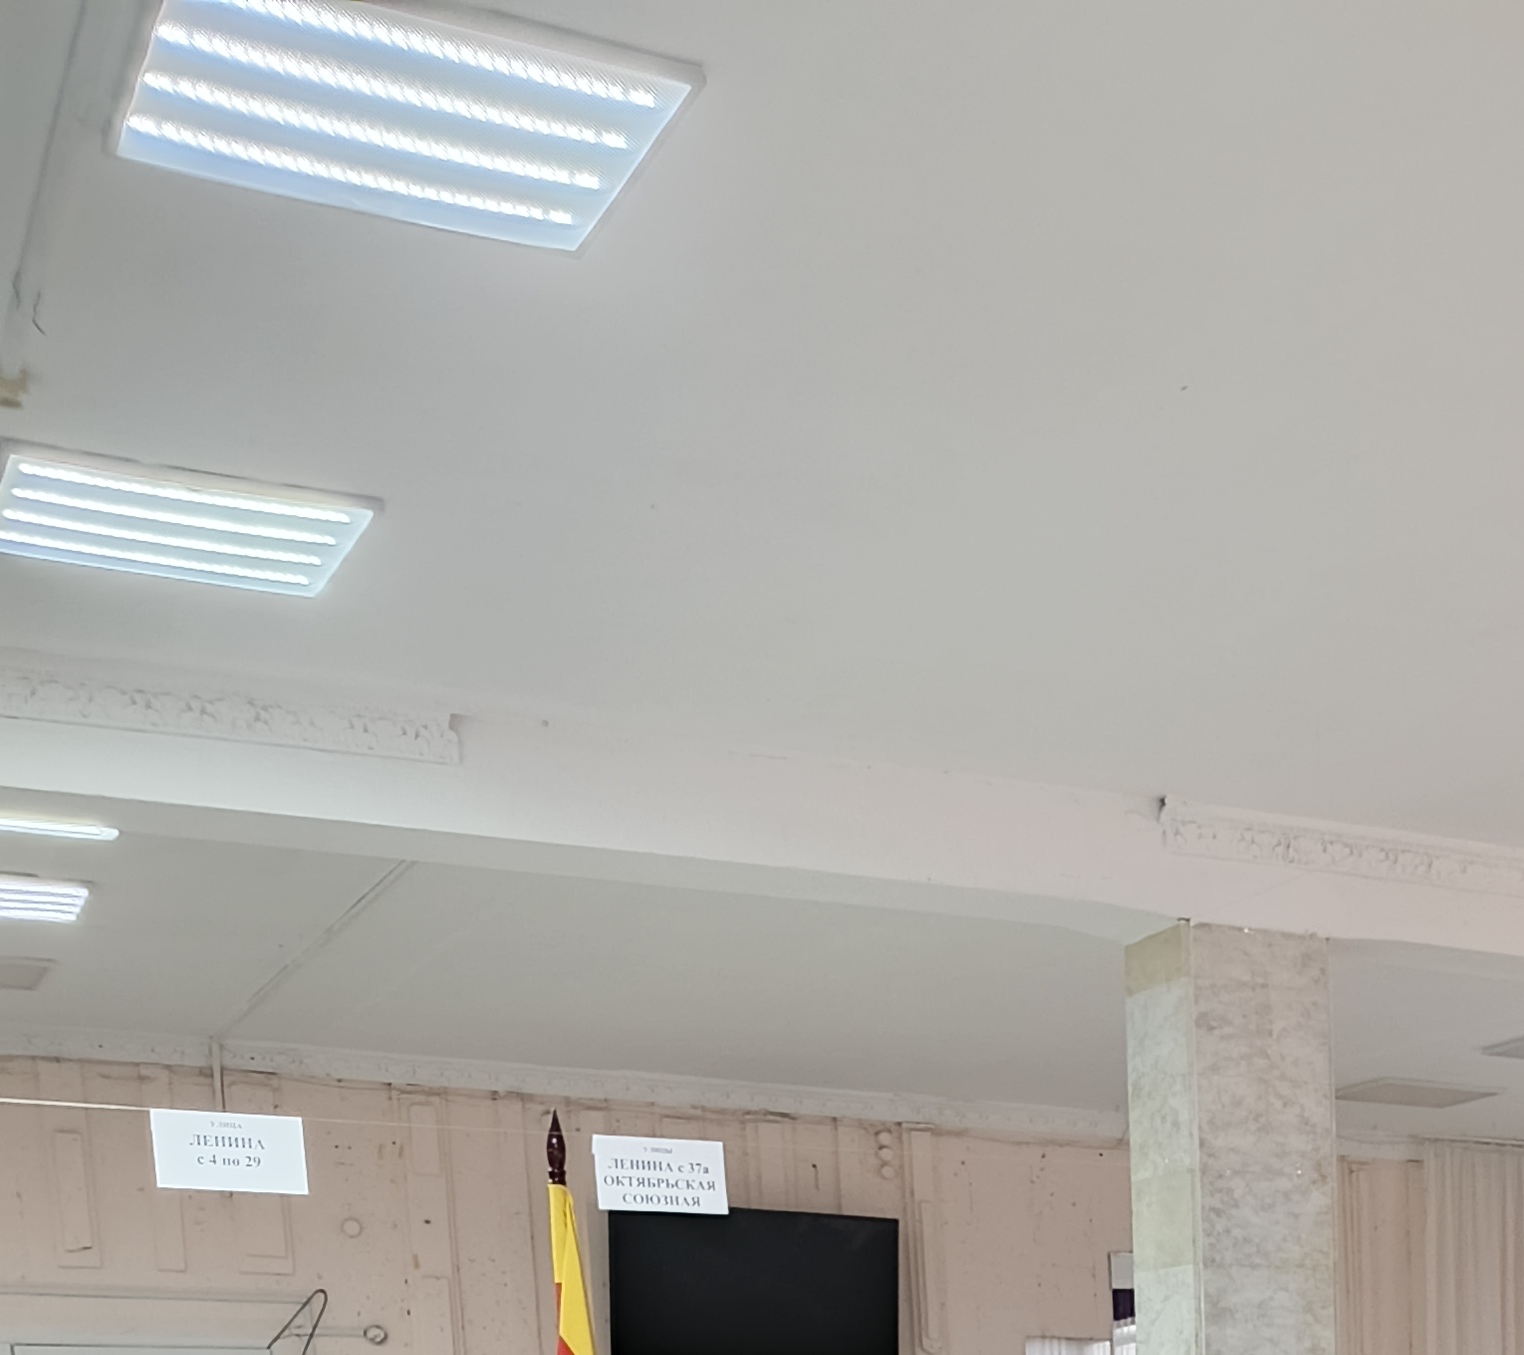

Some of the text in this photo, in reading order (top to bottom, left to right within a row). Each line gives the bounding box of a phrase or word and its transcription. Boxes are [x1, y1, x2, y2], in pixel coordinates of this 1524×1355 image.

[189, 1133, 265, 1150] ЛЕНИНА
[197, 1154, 261, 1168] с 4 по 29
[607, 1158, 710, 1174] ЛЕНИНА с 37а
[603, 1174, 716, 1192] ОКТЯБРЬСКАЯ
[622, 1192, 701, 1207] СОЮЗНАЯ
